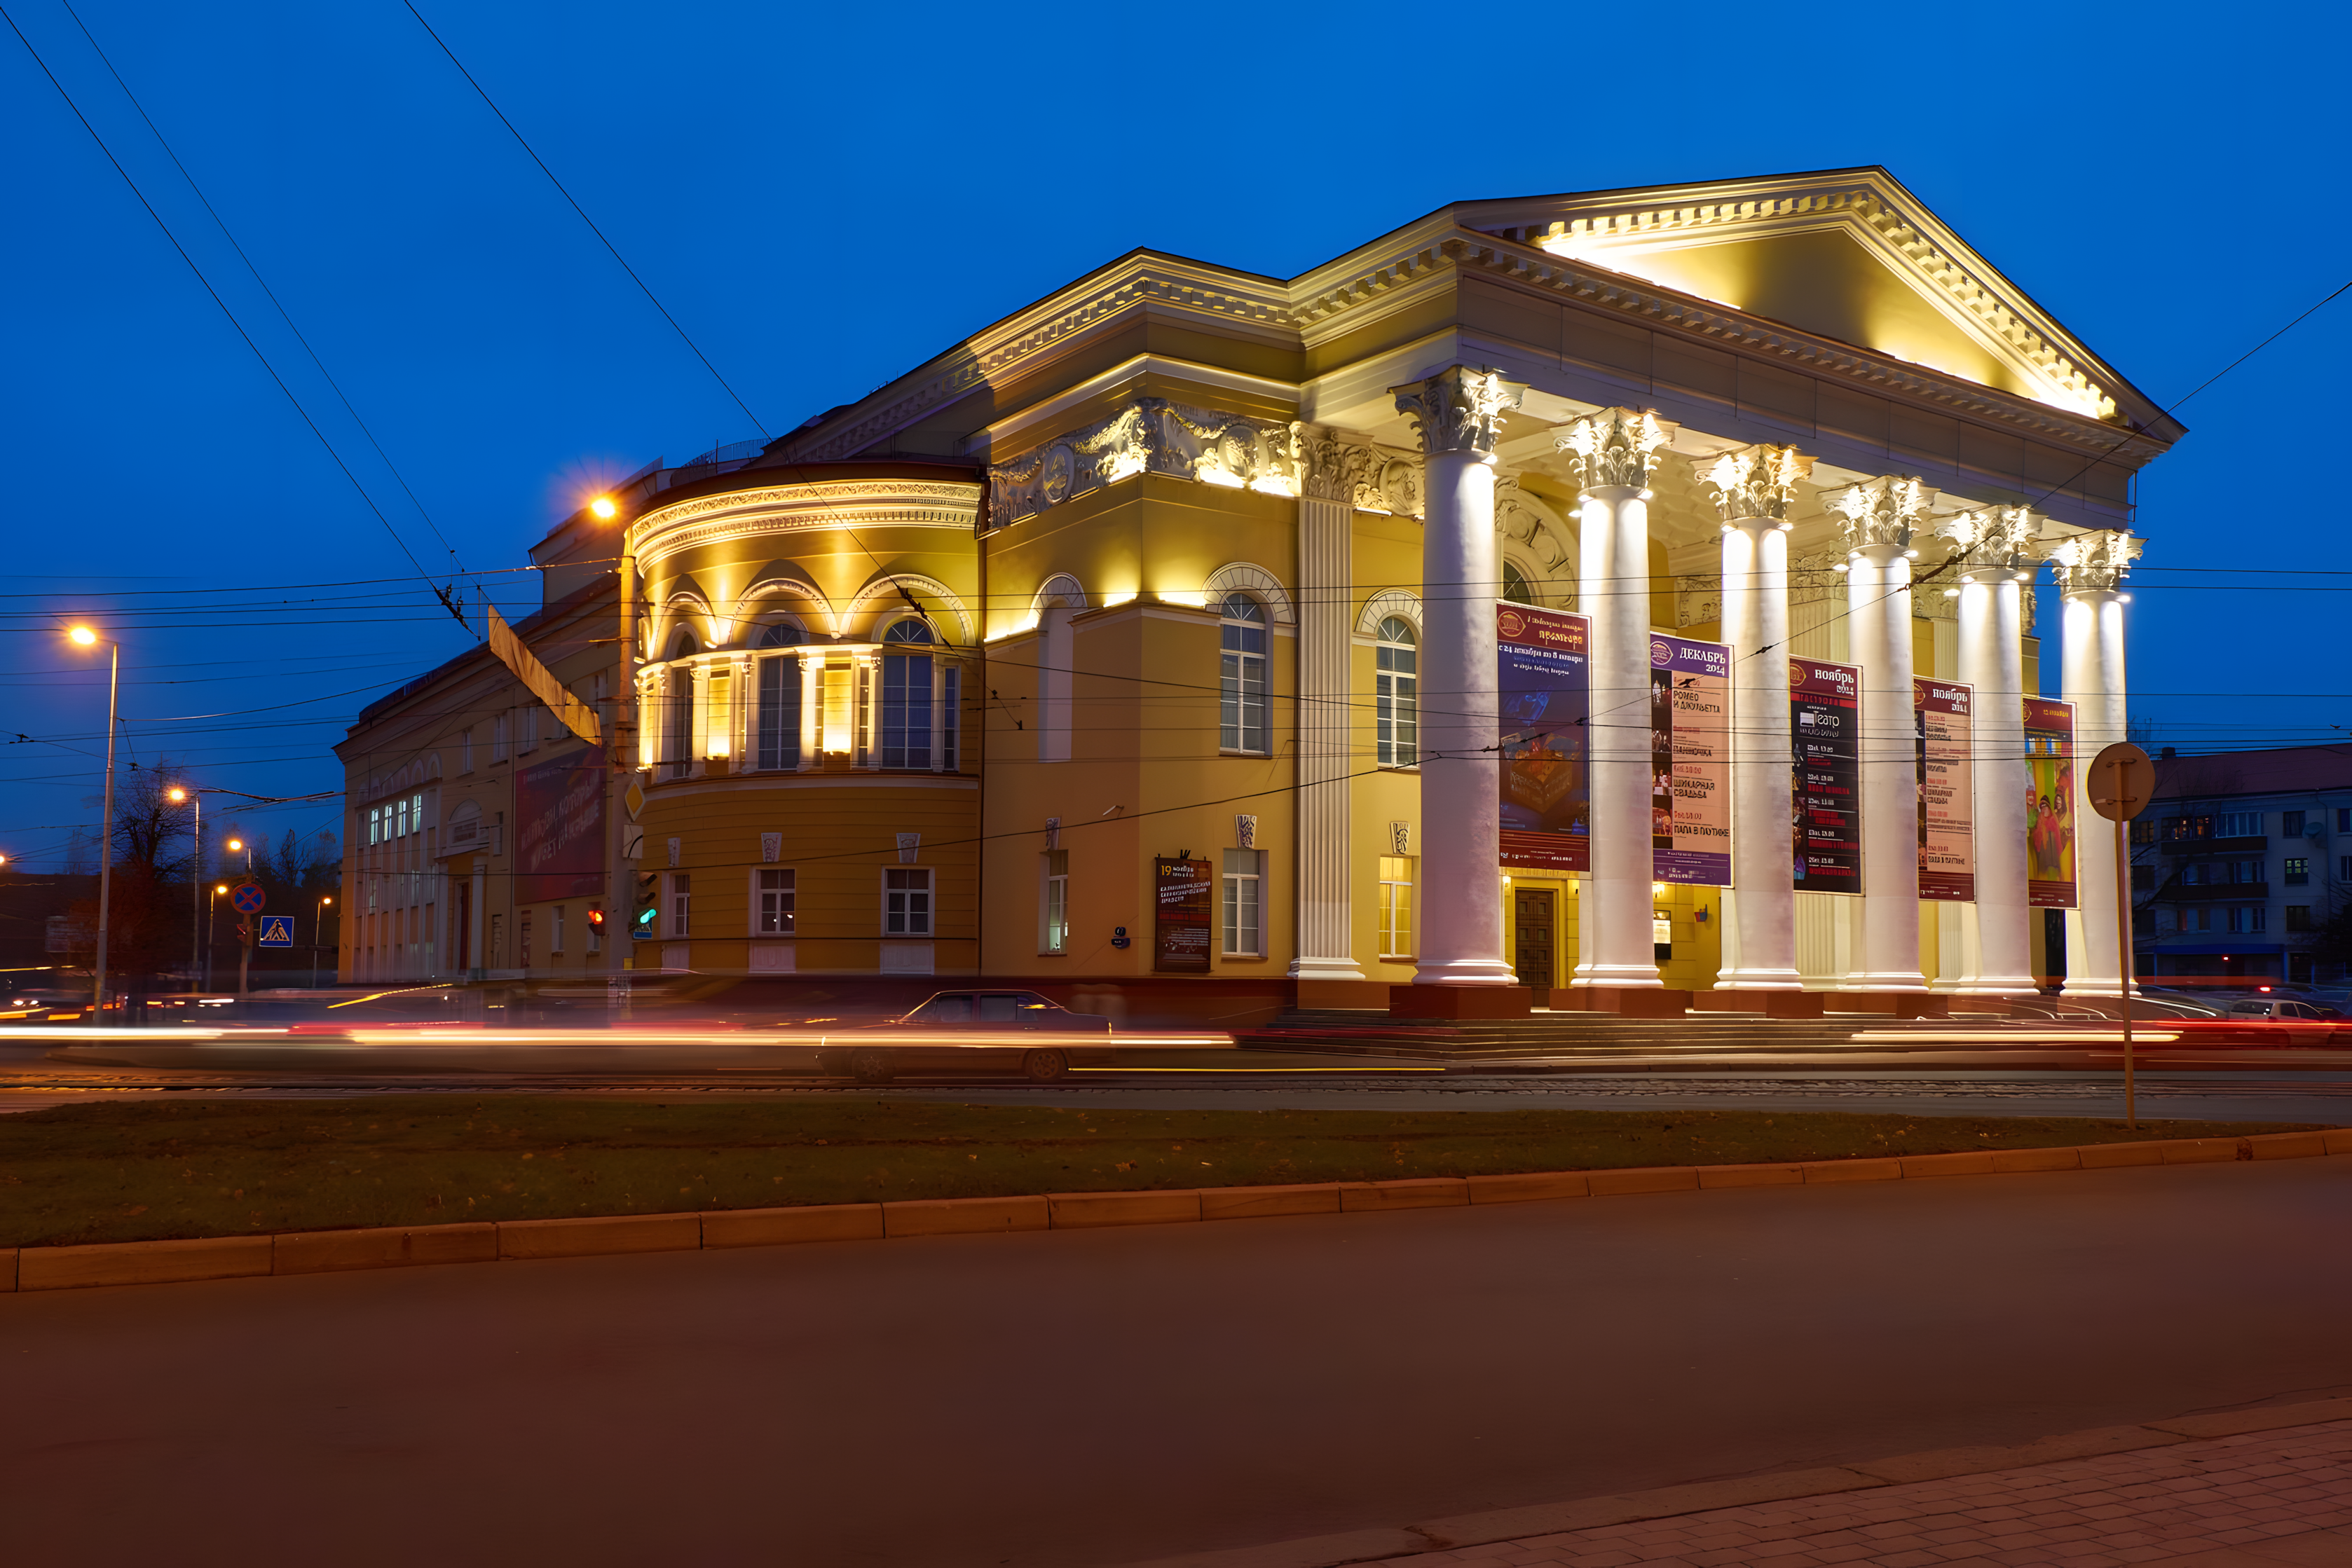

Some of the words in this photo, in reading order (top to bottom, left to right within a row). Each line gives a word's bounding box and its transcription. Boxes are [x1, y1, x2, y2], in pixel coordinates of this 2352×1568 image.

[1679, 647, 1725, 664] ДЕКАБРЬ
[1814, 669, 1854, 687] ноябрь
[1161, 865, 1172, 876] 19
